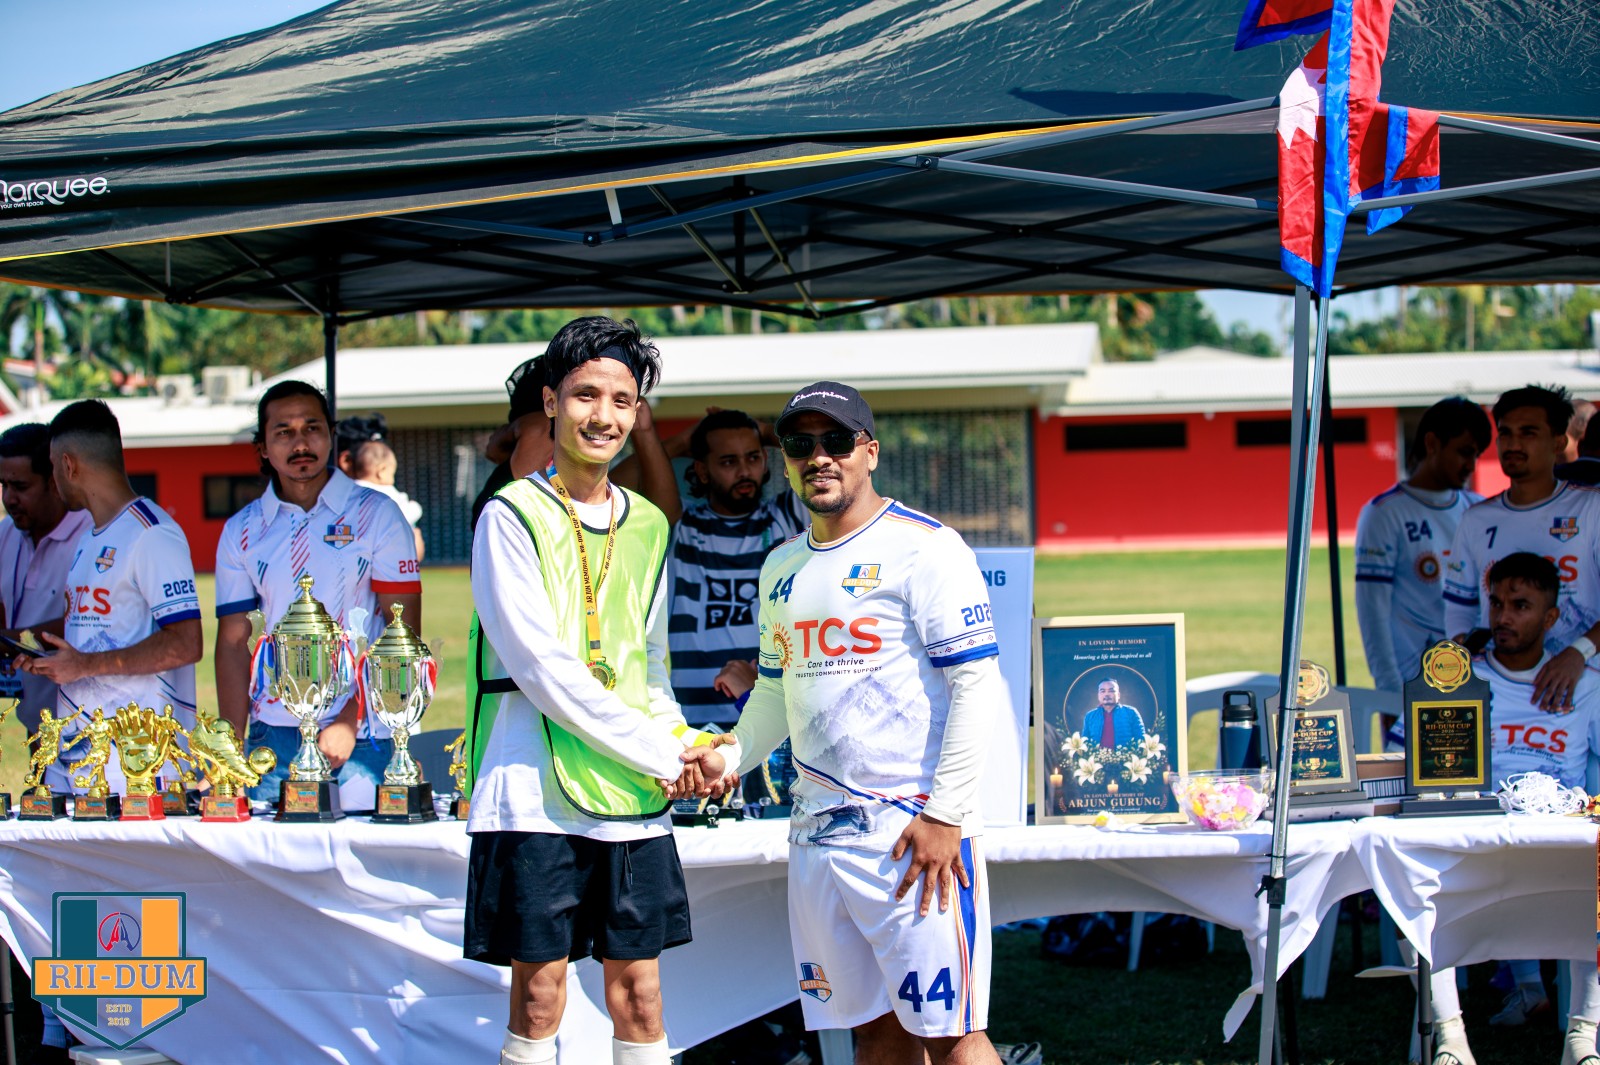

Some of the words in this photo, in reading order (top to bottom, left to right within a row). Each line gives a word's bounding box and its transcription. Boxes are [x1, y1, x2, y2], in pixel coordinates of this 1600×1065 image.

[790, 391, 848, 407] Champion
[1405, 520, 1432, 542] 24
[582, 556, 590, 584] MEMORIAL
[769, 573, 797, 606] 44
[961, 602, 992, 627] 202
[794, 617, 882, 658] TCS
[795, 670, 814, 678] TRUSTED
[815, 669, 851, 677] COMMUNITY
[854, 666, 882, 674] SUPPORT
[808, 661, 822, 669] Care
[837, 658, 864, 666] thrive
[1500, 724, 1568, 753] TCS
[1069, 799, 1106, 808] ARJUN
[1111, 797, 1160, 807] GURUNG
[898, 967, 955, 1013] 44
